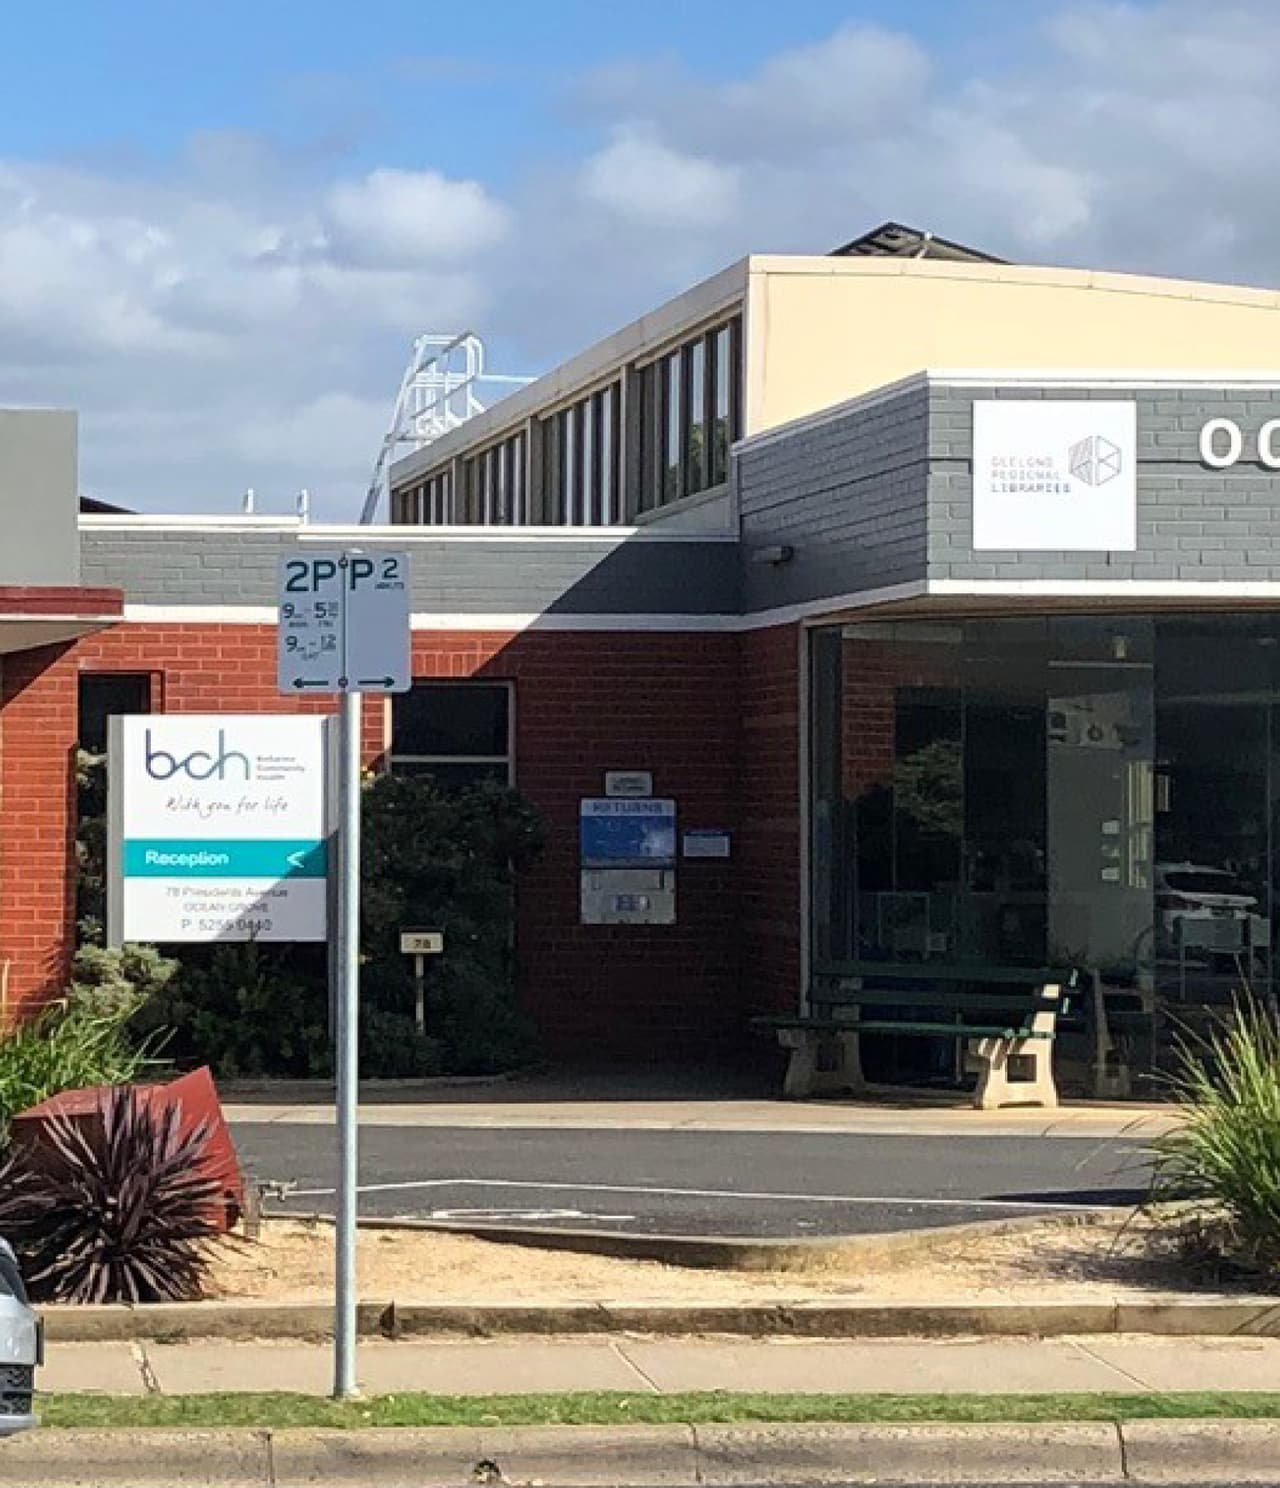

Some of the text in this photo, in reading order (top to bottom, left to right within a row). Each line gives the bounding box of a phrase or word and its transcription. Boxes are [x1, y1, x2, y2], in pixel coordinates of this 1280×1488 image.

[286, 559, 337, 592] 2P
[350, 557, 399, 590] P 2
[146, 729, 250, 780] bch
[236, 795, 258, 815] for
[264, 795, 289, 818] life
[145, 849, 230, 868] Reception
[183, 903, 226, 913] OCEAN
